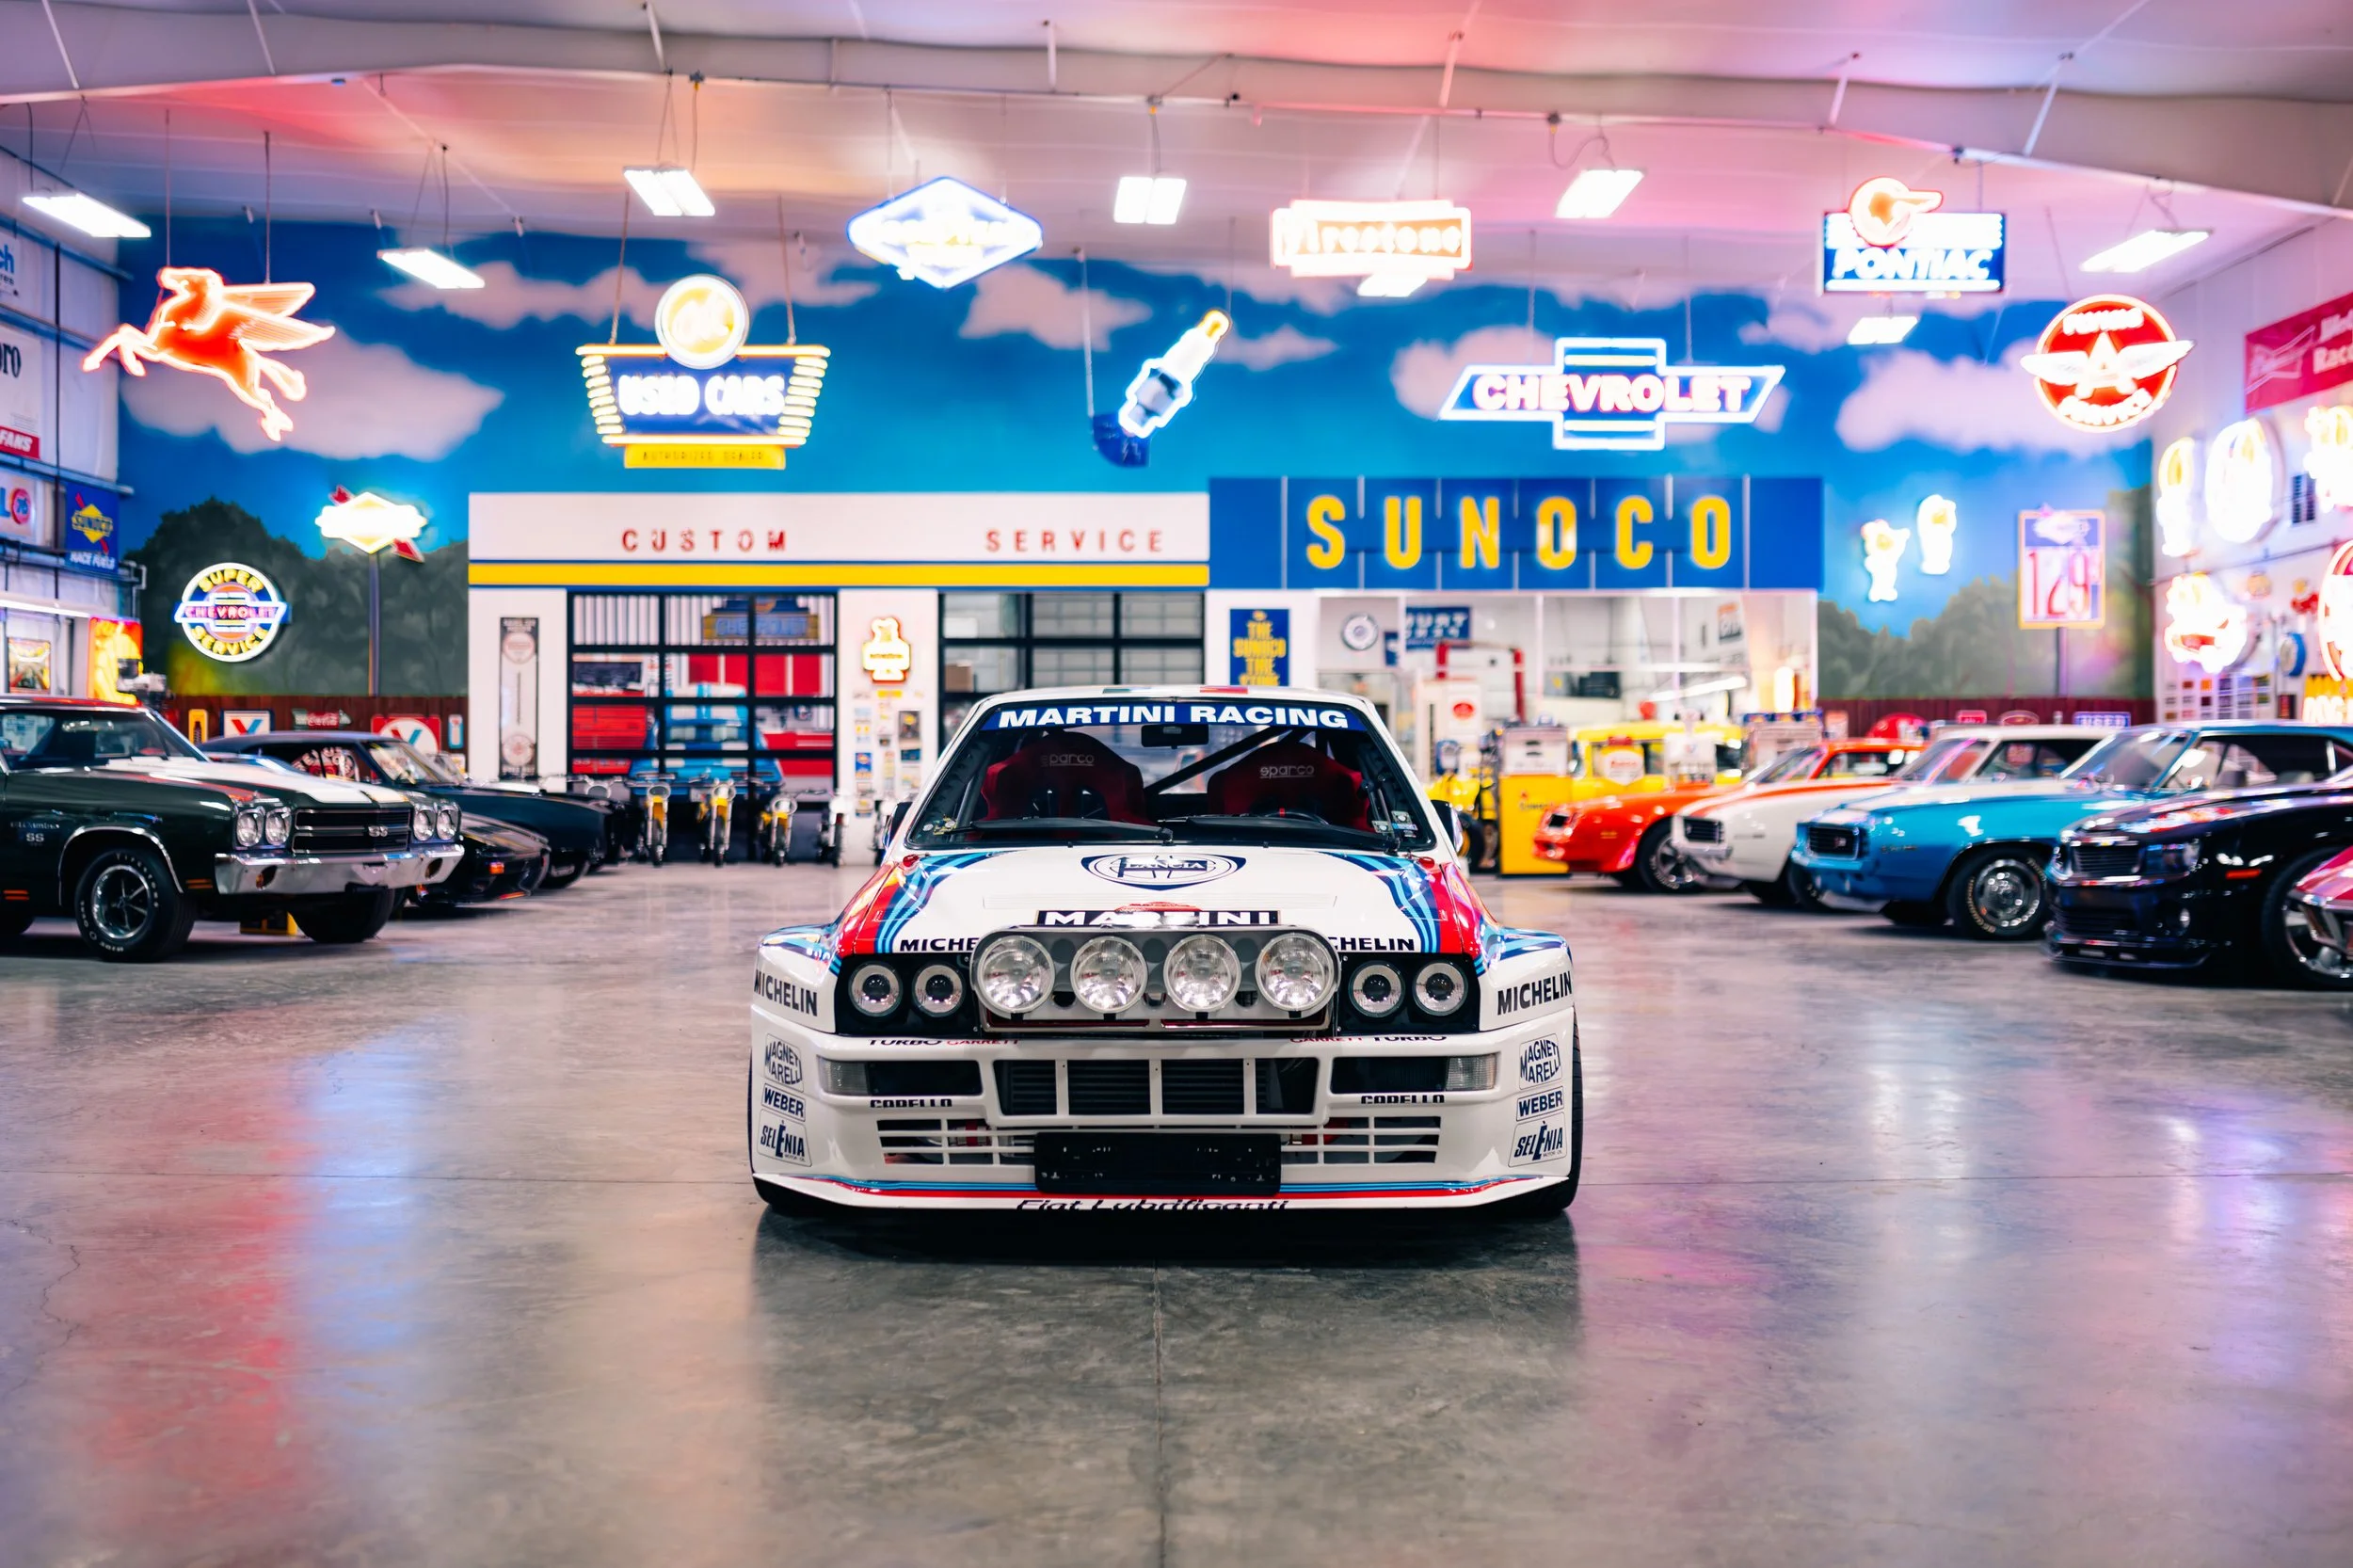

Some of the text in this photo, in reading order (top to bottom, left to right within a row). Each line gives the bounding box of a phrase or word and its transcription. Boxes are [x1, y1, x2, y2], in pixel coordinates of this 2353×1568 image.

[1832, 248, 1993, 280] PONTIAC
[618, 375, 786, 416] USED CARS
[1472, 374, 1753, 412] CHEVROLET
[621, 528, 1164, 553] CUSTOM SERVICE
[1306, 495, 1732, 570] SUNOCO
[199, 568, 264, 593] SUPER
[184, 605, 277, 618] CHEVROLET
[191, 625, 268, 656] SERVICE
[999, 706, 1350, 728] MARTINI RACING
[1260, 765, 1315, 779] sparco
[26, 832, 44, 842] SS
[1125, 858, 1206, 870] LANCIA
[1045, 910, 1270, 926] MARTINI
[754, 969, 817, 1017] MICHELIN
[1497, 971, 1572, 1016] MICHELIN
[764, 1087, 804, 1118] WEBER
[1519, 1090, 1562, 1117] WEBER
[1016, 1199, 1083, 1210] Fiat
